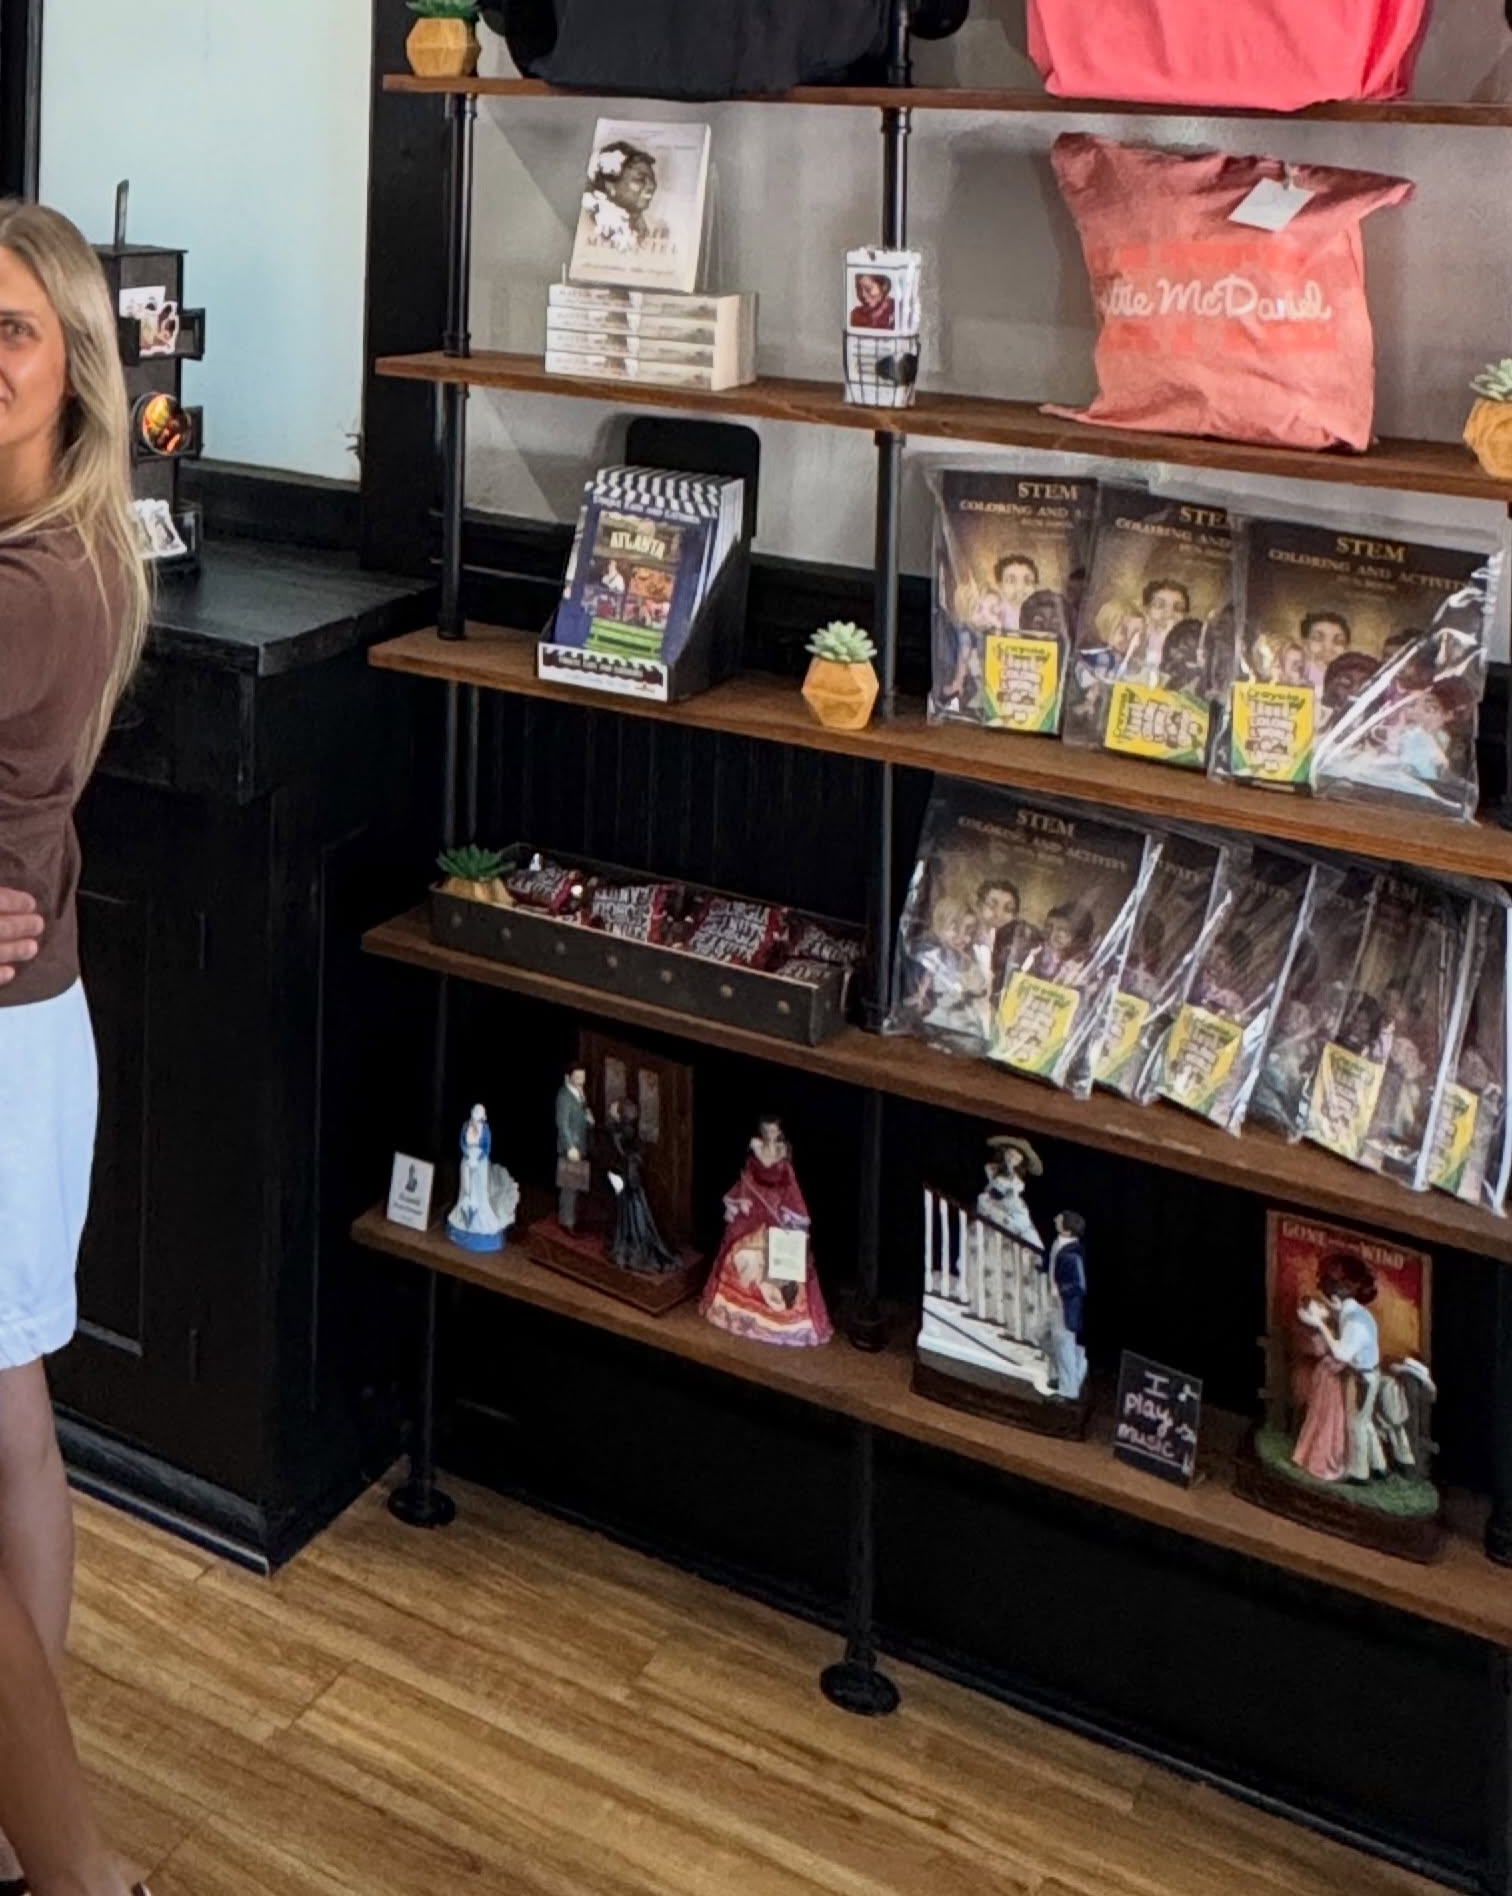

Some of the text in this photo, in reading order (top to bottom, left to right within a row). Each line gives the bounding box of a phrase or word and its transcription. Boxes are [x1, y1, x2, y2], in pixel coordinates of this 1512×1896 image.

[1100, 278, 1152, 317] ttie
[1018, 481, 1079, 501] STEM
[609, 531, 666, 560] ATLANTA
[1336, 536, 1406, 564] STEM
[1398, 571, 1470, 592] ACTIVIT
[1124, 1392, 1174, 1439] play
